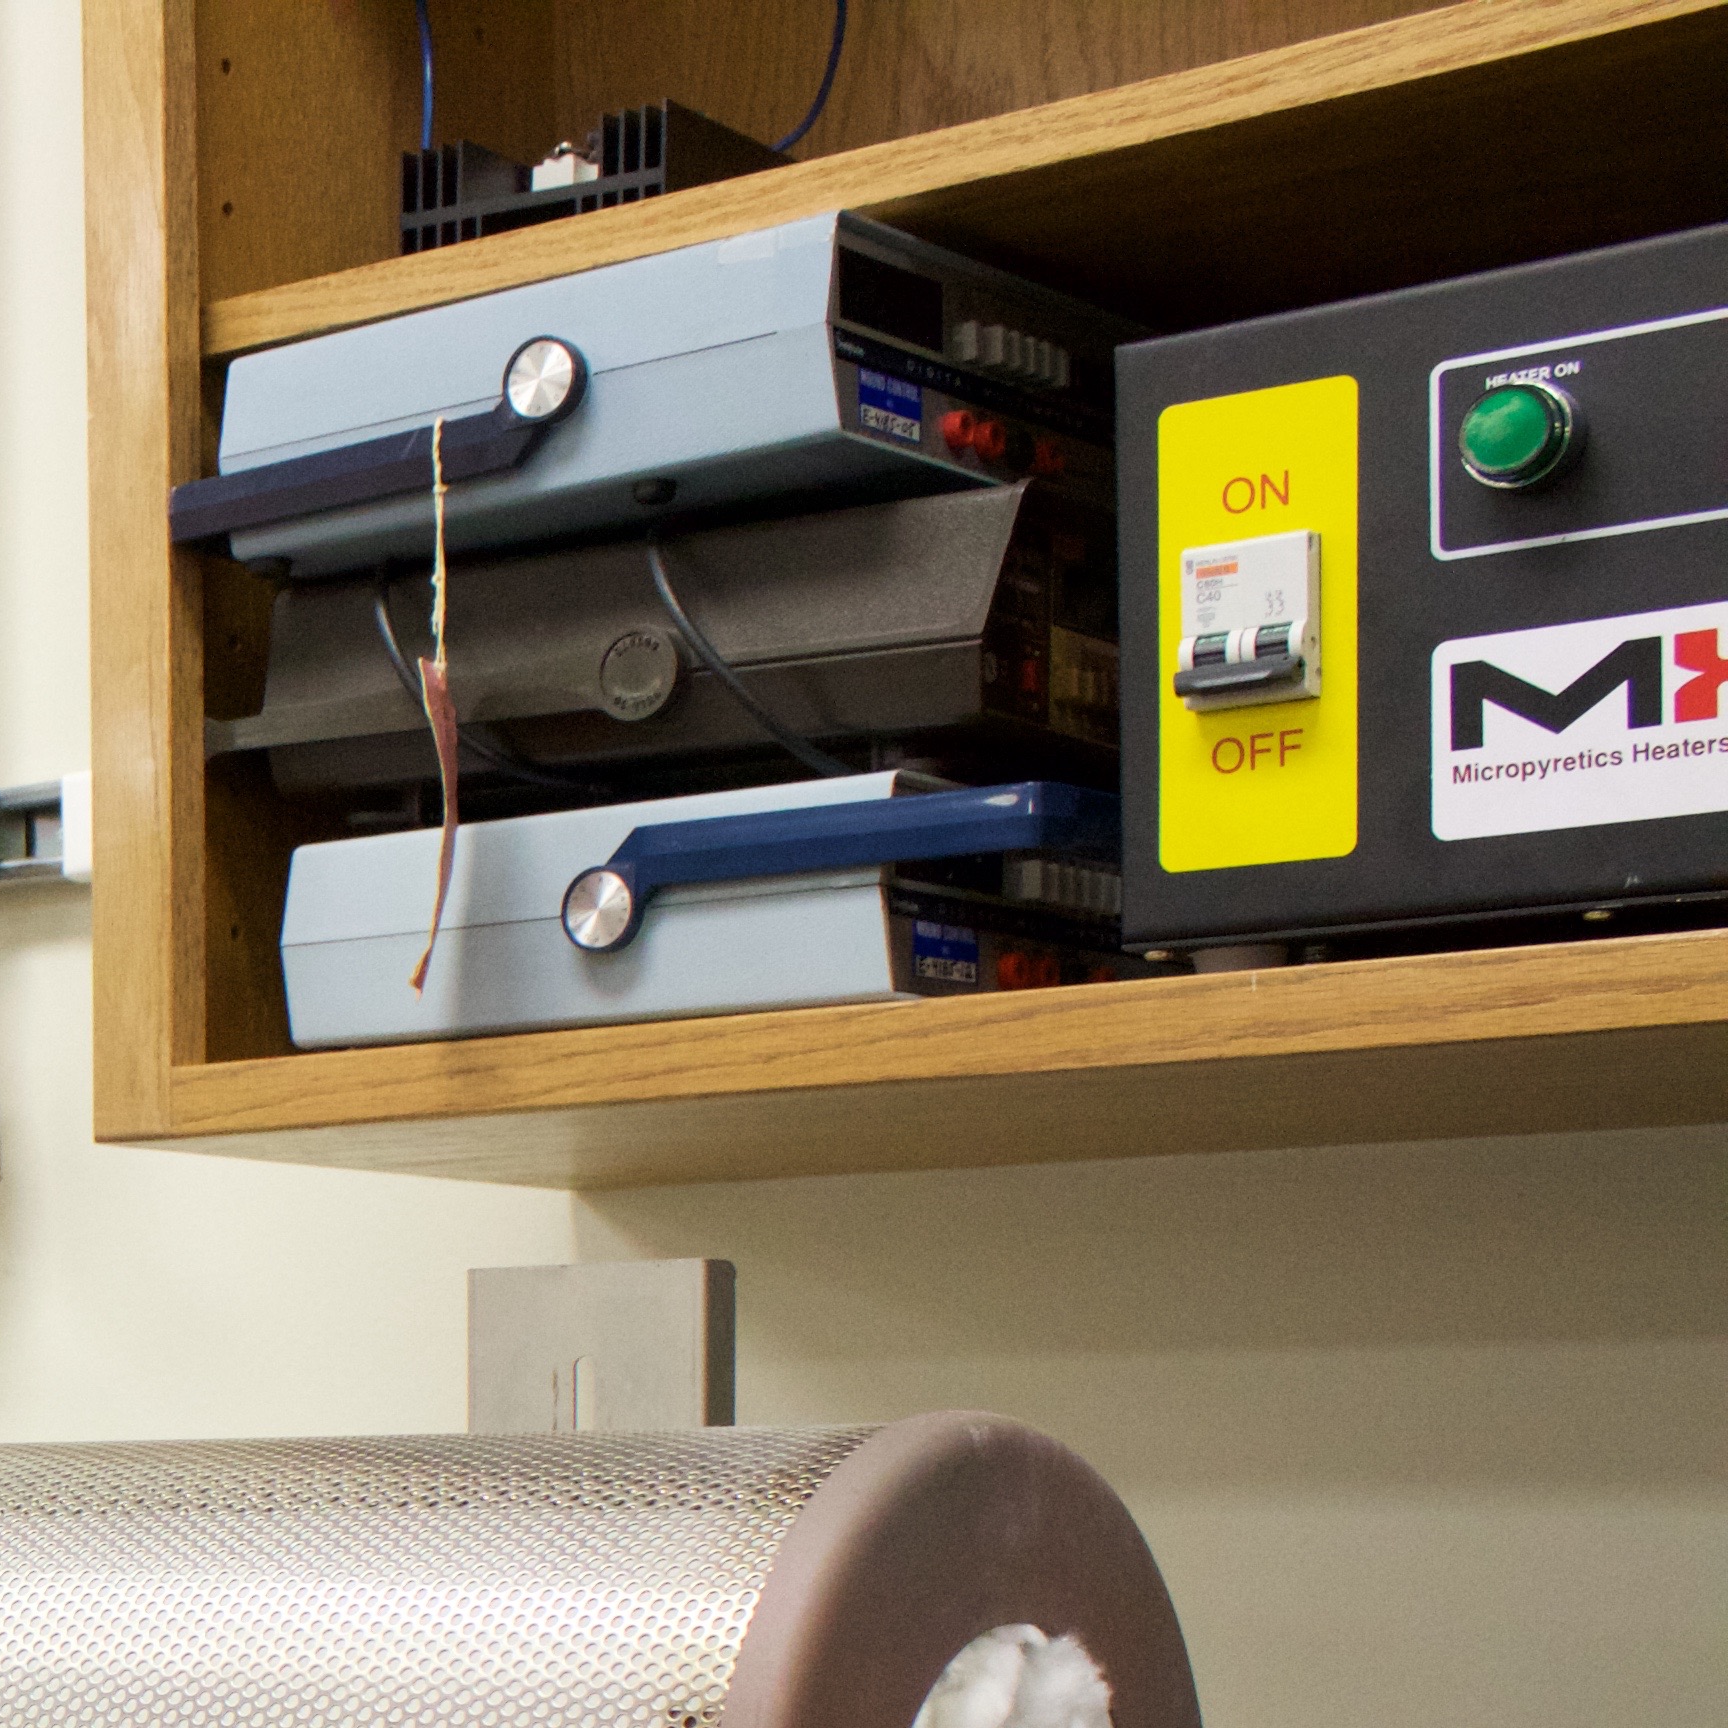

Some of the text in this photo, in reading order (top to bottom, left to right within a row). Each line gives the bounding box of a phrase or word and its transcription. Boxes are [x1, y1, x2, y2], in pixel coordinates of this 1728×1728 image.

[1485, 361, 1581, 390] HEATER ON
[1222, 469, 1290, 514] ON
[1196, 589, 1222, 605] C40
[1211, 728, 1304, 774] OFF
[1451, 748, 1623, 785] Micropyretics
